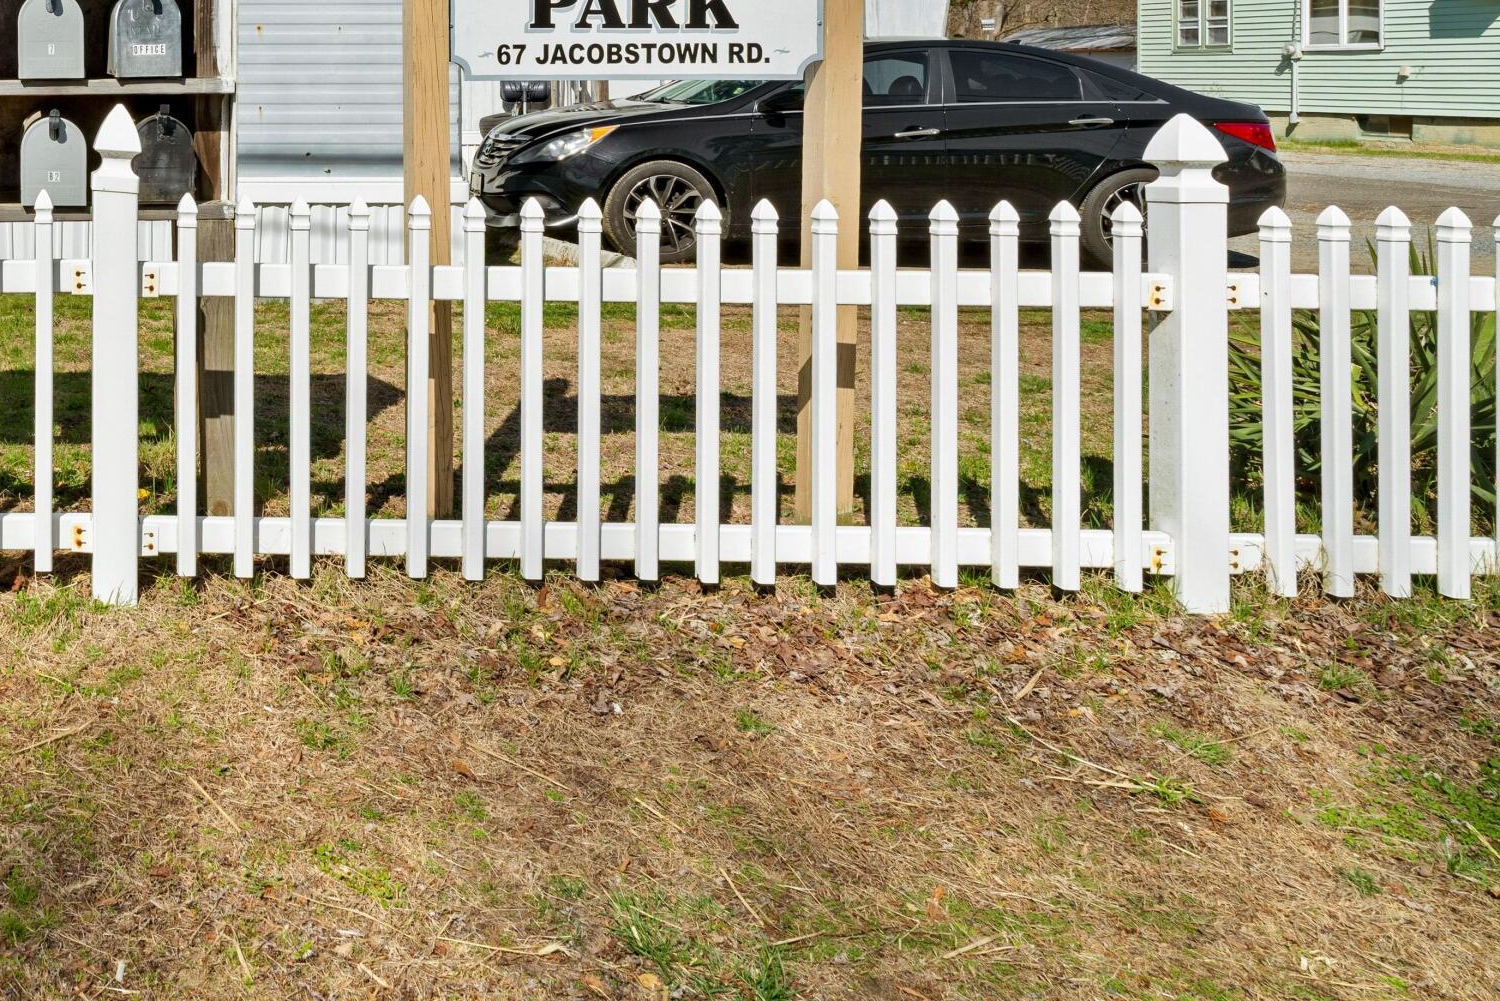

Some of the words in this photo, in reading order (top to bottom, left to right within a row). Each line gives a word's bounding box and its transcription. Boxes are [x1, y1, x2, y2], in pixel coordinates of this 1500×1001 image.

[133, 45, 165, 54] OFFICE
[496, 43, 526, 65] 67
[535, 42, 718, 65] JACOBSTOWN
[728, 42, 770, 64] RD.
